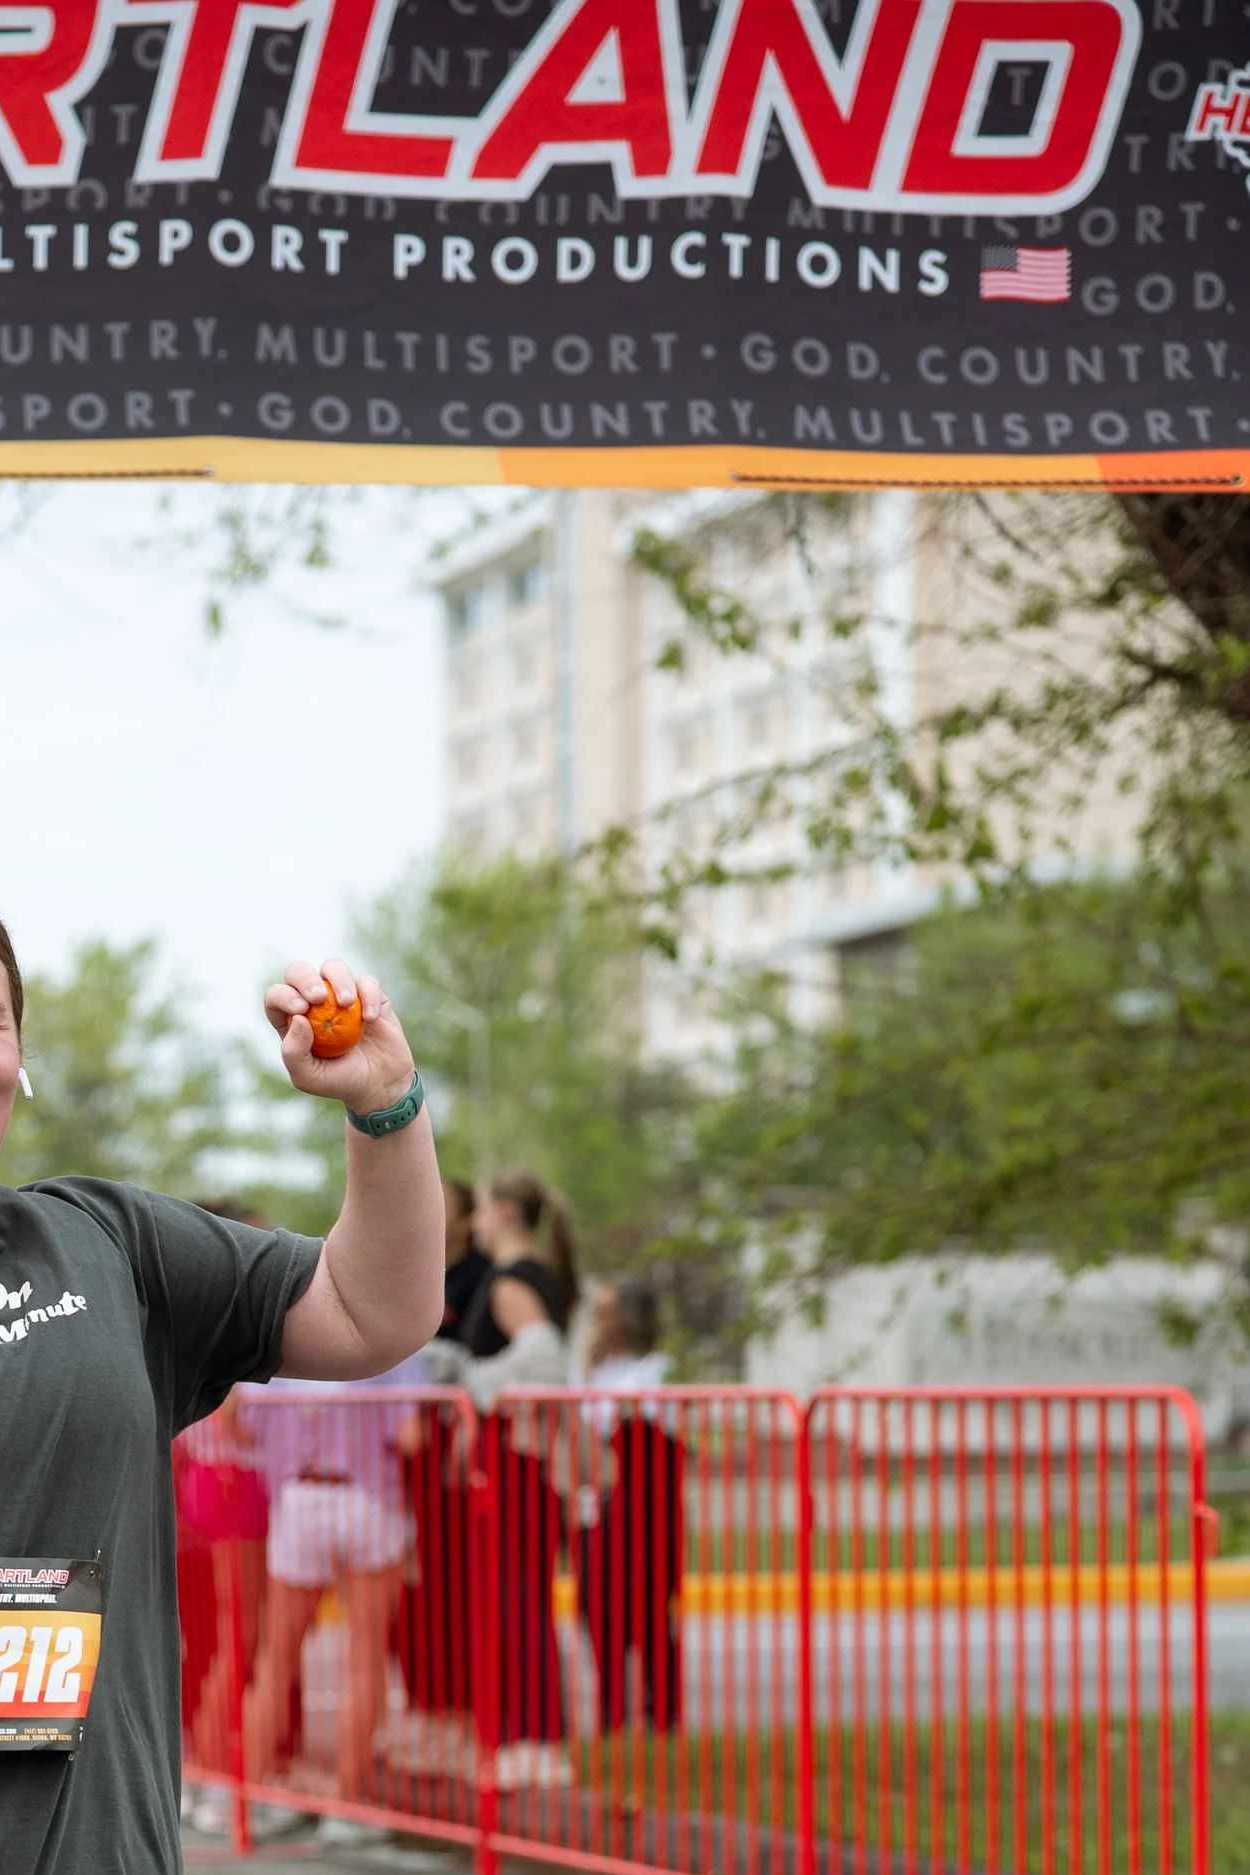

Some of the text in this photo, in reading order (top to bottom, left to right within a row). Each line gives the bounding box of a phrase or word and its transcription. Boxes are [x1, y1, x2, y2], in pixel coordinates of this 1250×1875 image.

[393, 231, 950, 296] PRODUCTIONS
[255, 322, 678, 375] MULTISPORT
[794, 405, 1214, 448] MULTISPORT
